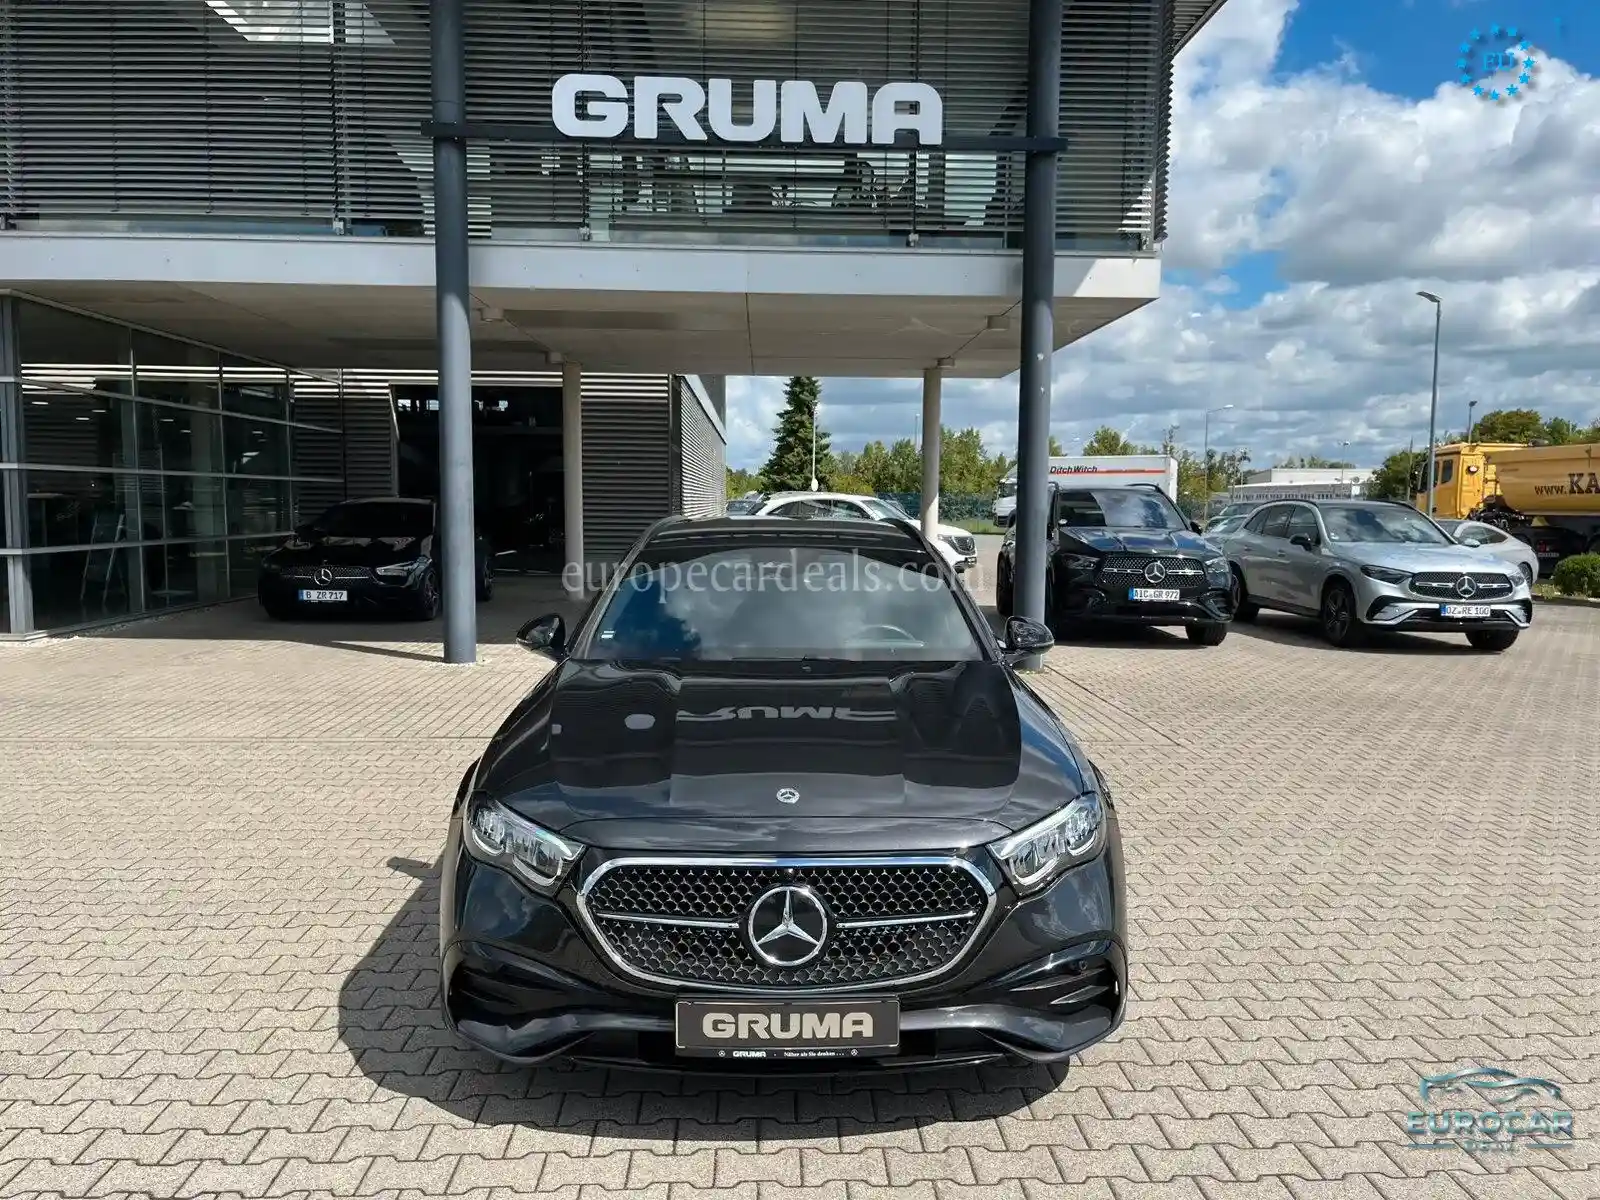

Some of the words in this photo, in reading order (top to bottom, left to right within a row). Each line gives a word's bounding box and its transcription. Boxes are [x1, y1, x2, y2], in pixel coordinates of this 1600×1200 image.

[552, 74, 942, 145] GRUMA
[702, 1012, 874, 1040] GRUMA
[732, 1050, 767, 1058] GRUMA
